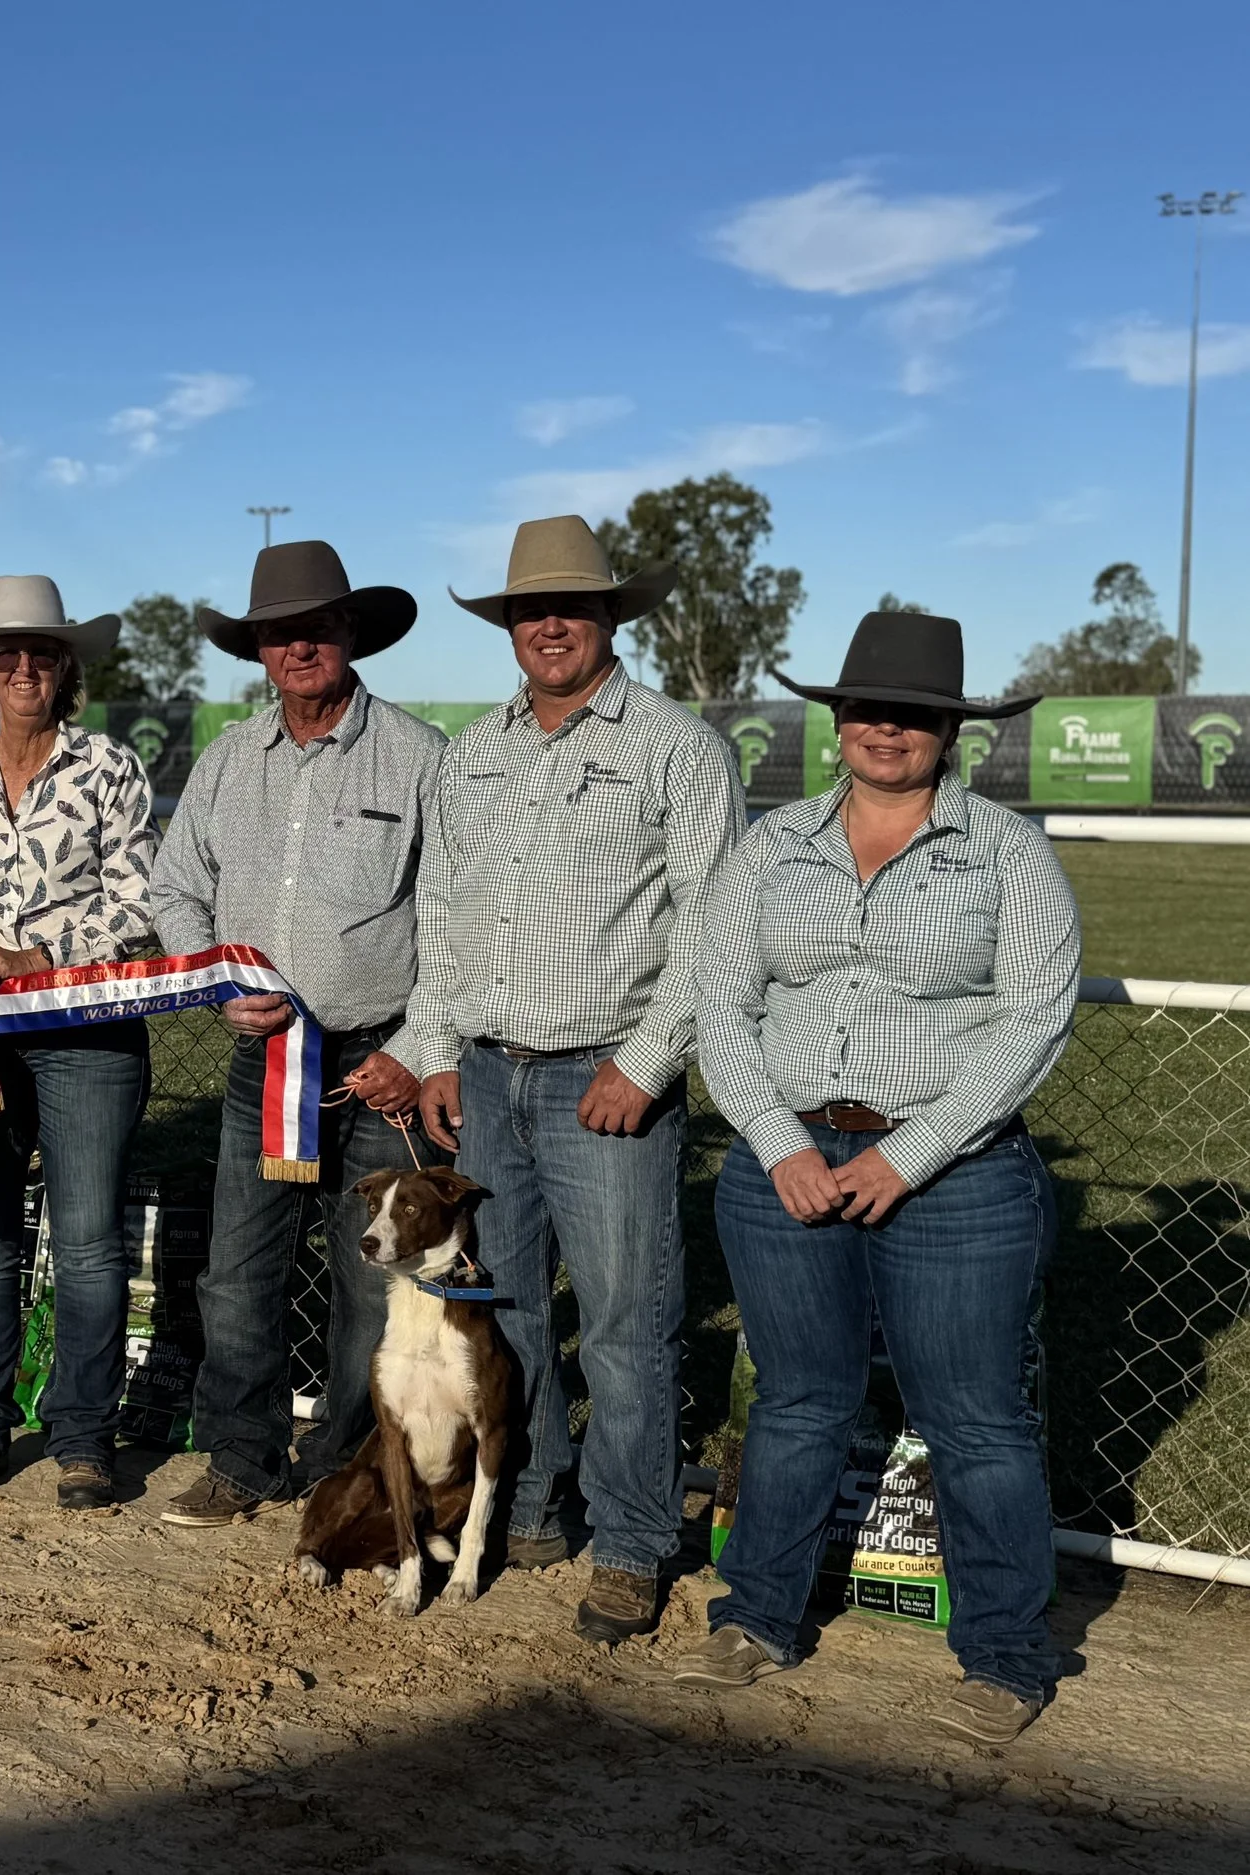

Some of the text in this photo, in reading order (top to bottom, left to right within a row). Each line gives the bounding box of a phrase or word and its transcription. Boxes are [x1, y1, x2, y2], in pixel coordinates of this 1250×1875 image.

[1064, 723, 1122, 749] FRAME
[136, 981, 162, 994] TOP
[165, 974, 203, 989] PRICE
[82, 988, 217, 1022] WORKING DOG
[152, 1369, 187, 1392] dogs
[882, 1474, 917, 1494] High
[879, 1495, 934, 1517] energy
[877, 1509, 914, 1529] food
[827, 1524, 937, 1556] orking dogs
[852, 1556, 936, 1572] durance Counts
